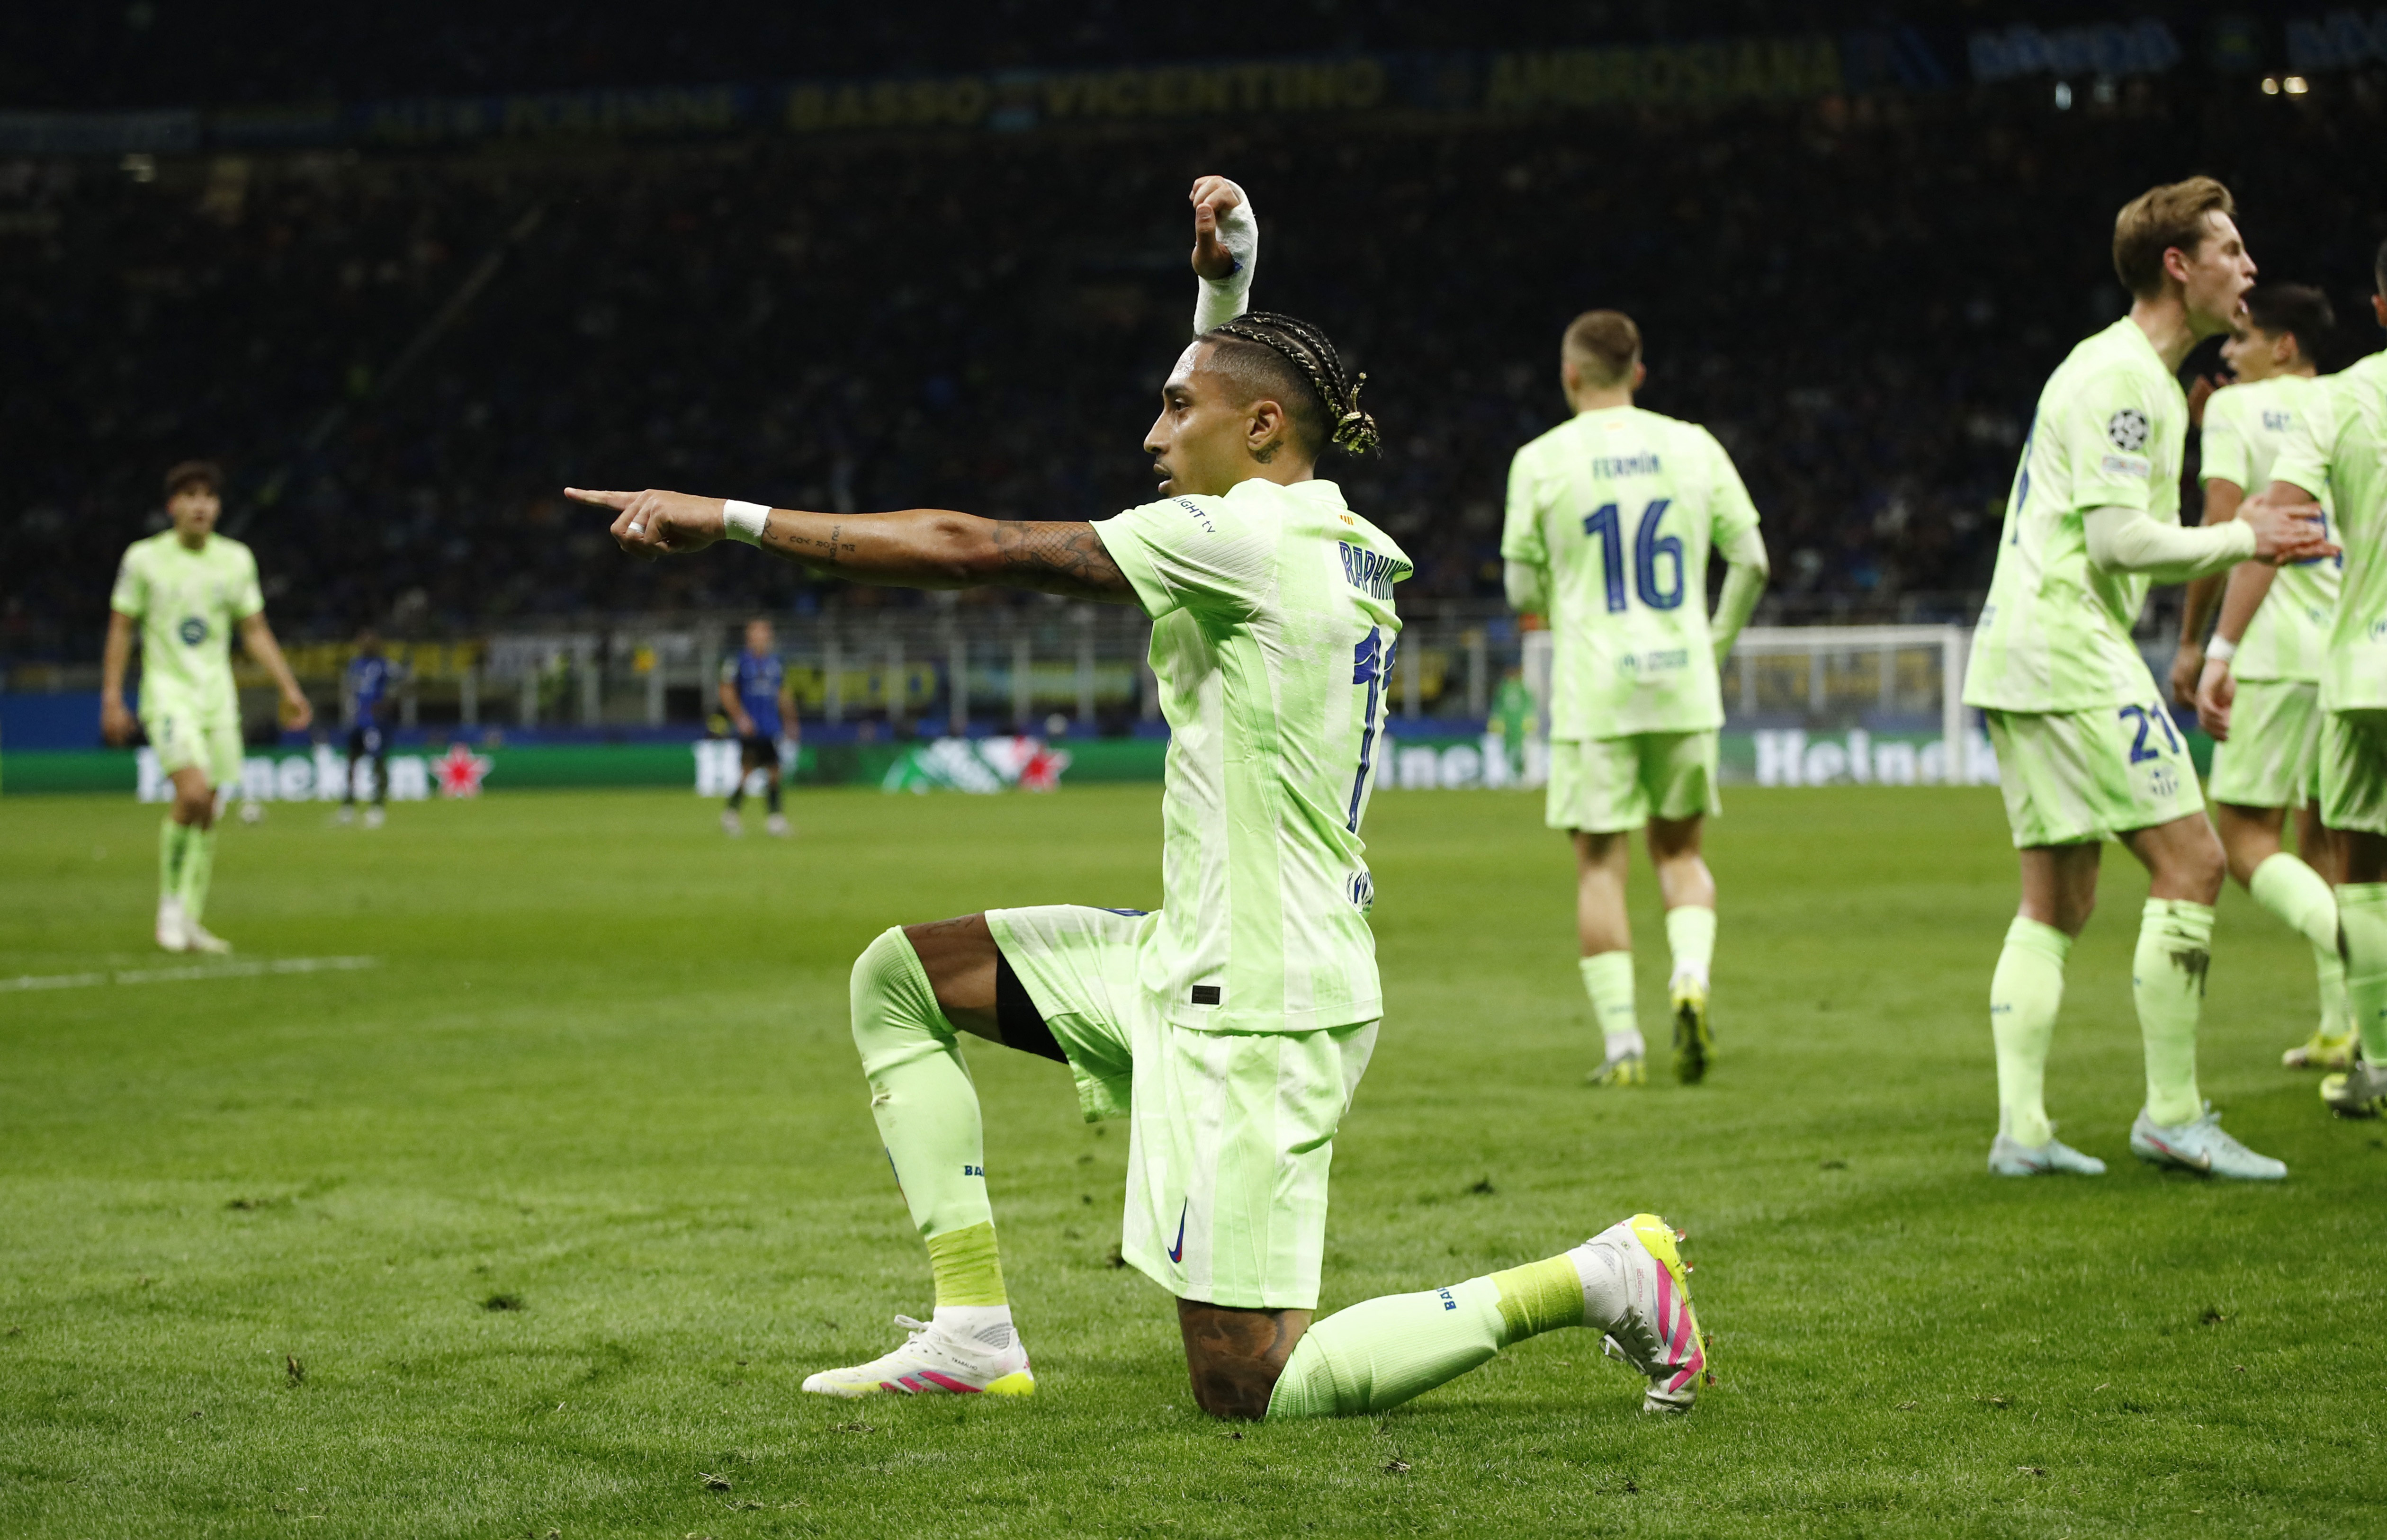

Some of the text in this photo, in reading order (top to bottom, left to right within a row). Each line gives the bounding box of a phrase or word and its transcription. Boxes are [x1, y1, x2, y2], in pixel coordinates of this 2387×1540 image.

[784, 79, 989, 133] BASSO
[1582, 498, 1685, 612] 16
[1754, 728, 2000, 787] Heinek
[2119, 704, 2180, 765] 21
[964, 1165, 985, 1177] BA
